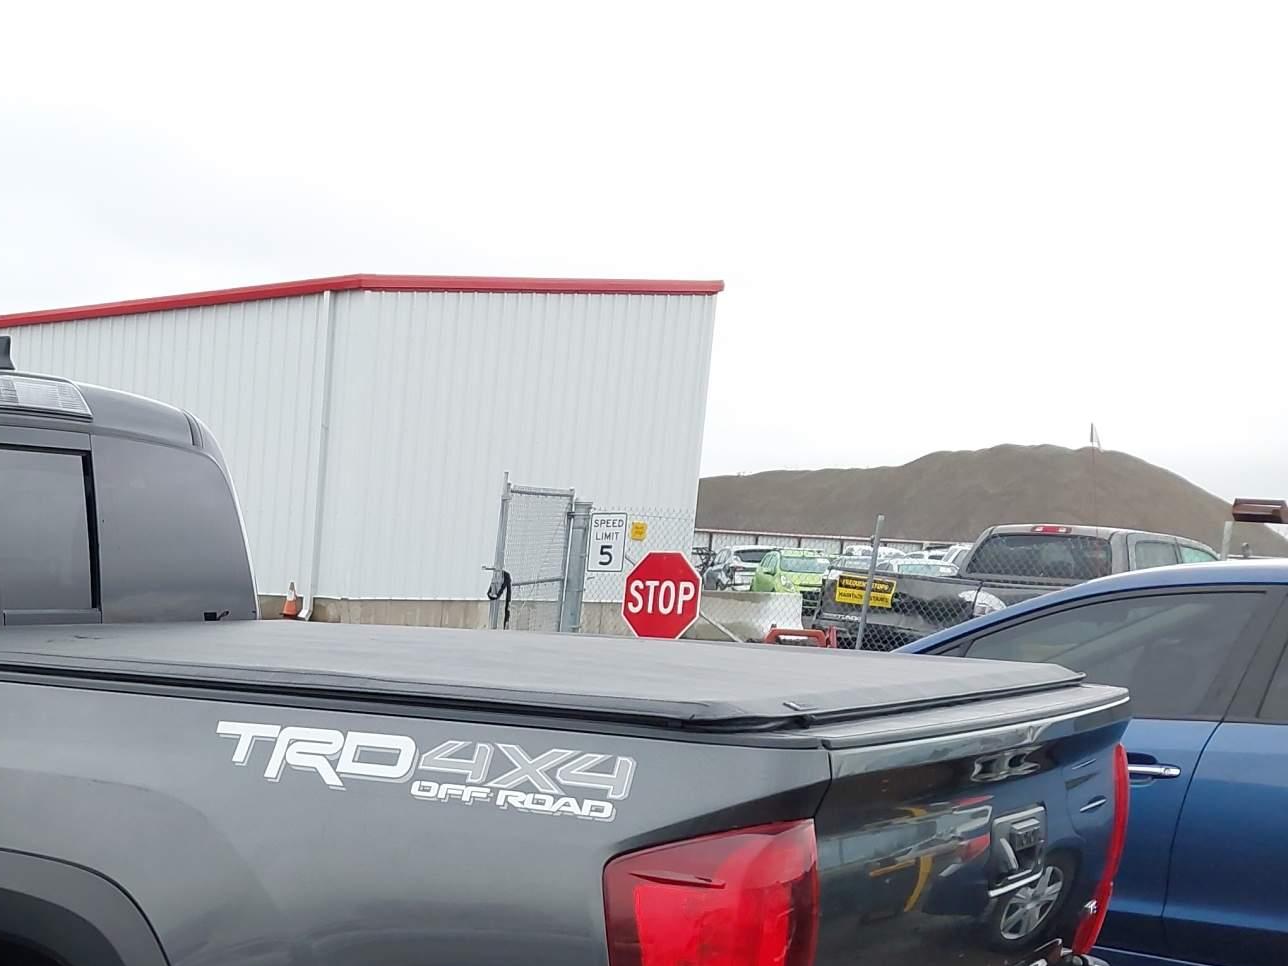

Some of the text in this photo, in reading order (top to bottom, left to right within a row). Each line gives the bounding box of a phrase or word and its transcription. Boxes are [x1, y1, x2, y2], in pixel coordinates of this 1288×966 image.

[594, 519, 624, 528] SPEED
[595, 532, 621, 541] LIMIT
[598, 544, 613, 566] 5
[627, 580, 696, 615] STOP
[216, 720, 636, 800] TRD 4X4
[410, 780, 616, 822] OFF ROAD
